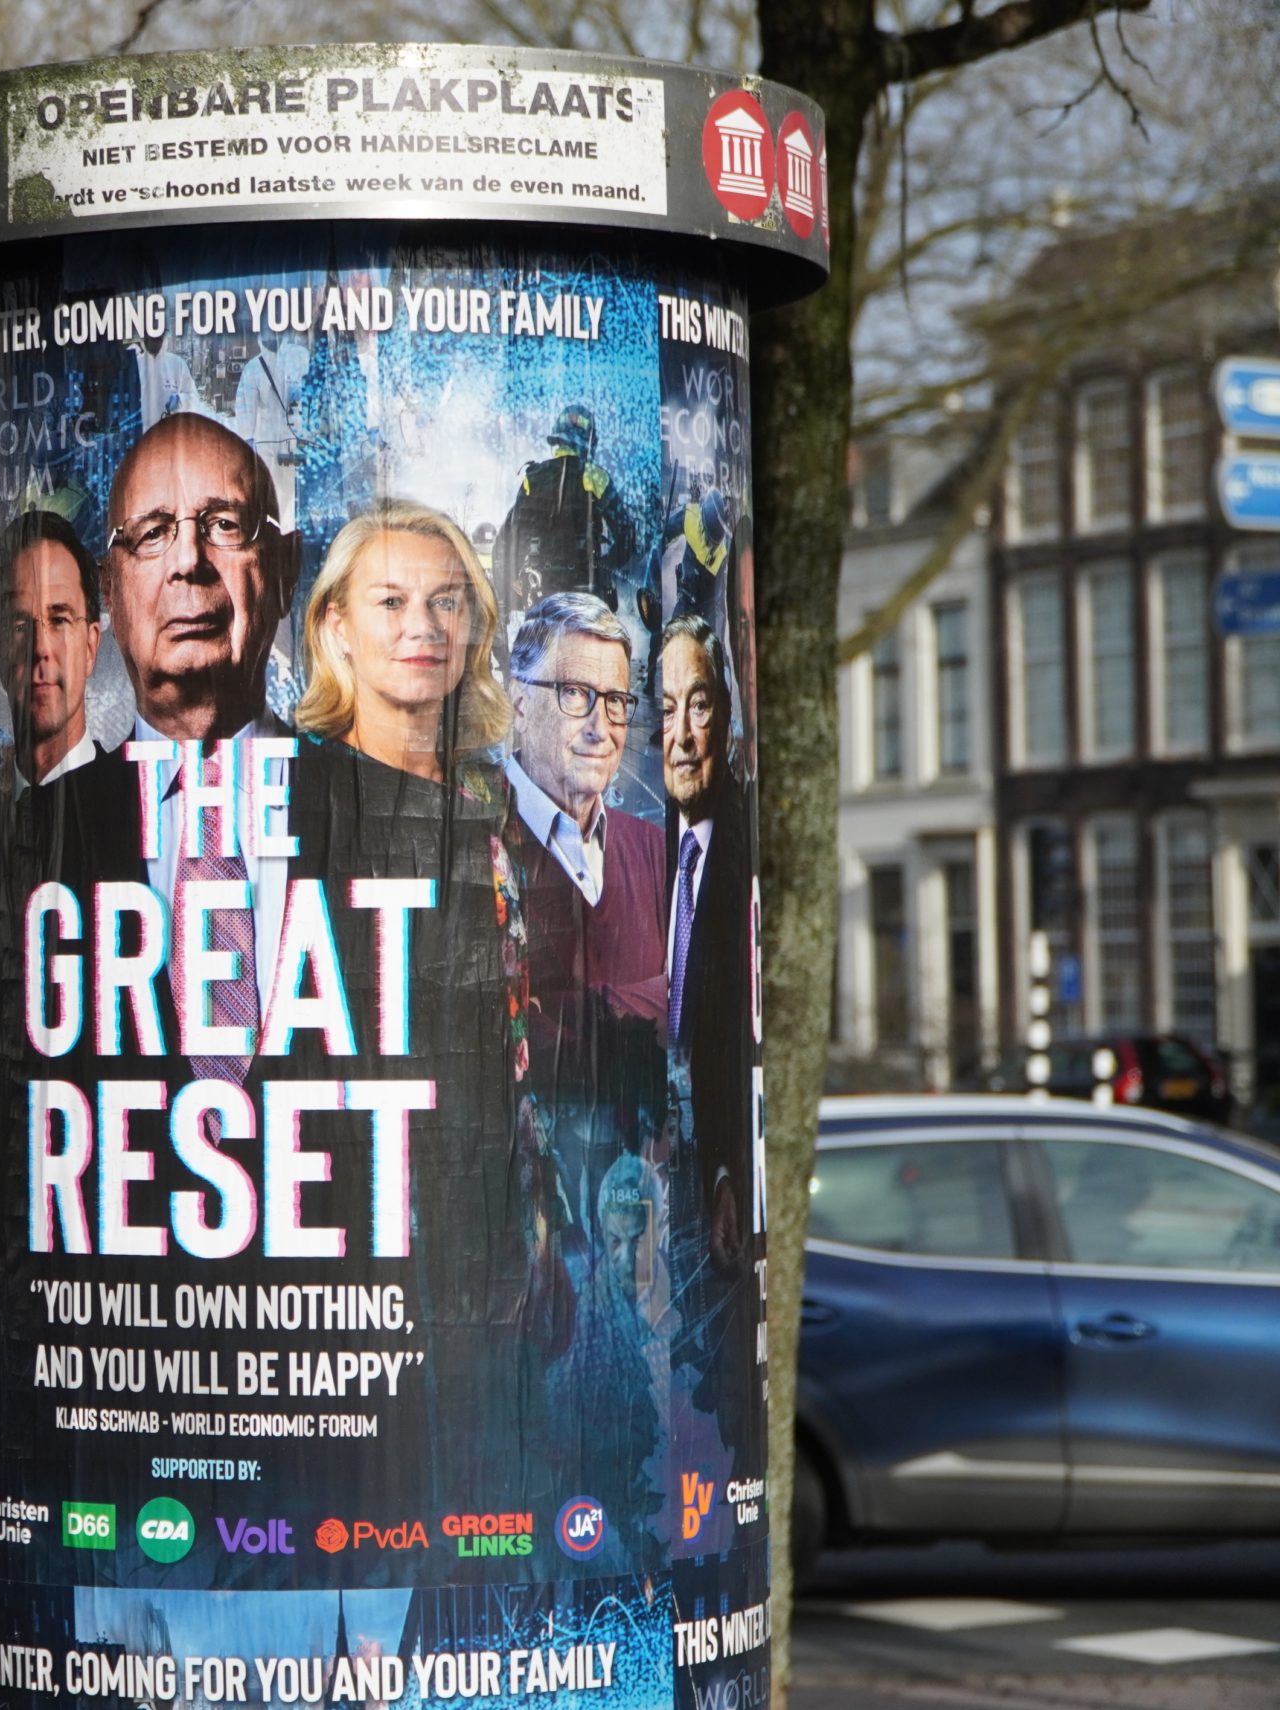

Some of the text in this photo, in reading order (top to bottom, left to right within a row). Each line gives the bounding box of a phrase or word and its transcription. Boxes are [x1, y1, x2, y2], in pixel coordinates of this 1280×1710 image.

[37, 76, 633, 131] OPENBARE PLAKPLAATS
[82, 134, 598, 167] NIET BESTEMD VOOR HANDELSRECLAME
[250, 174, 335, 195] laatste
[346, 173, 411, 192] week
[420, 176, 463, 192] van
[472, 175, 501, 194] de
[510, 179, 563, 195] even
[571, 180, 646, 203] maand.
[54, 294, 165, 347] COMING
[175, 289, 237, 336] FOR
[243, 288, 312, 333] YOU
[322, 287, 393, 331] AND
[401, 286, 490, 335] YOUR
[500, 290, 604, 340] FAMILY
[658, 294, 702, 345] THIS
[125, 738, 300, 859] THE
[25, 879, 437, 1058] GREAT
[27, 1079, 437, 1259] RESET
[99, 1282, 168, 1328] WILL
[175, 1285, 247, 1329] OWN
[256, 1285, 415, 1334] NOTHING,
[33, 1344, 83, 1390] AND
[90, 1347, 146, 1393] YOU
[154, 1350, 228, 1395] WILL
[237, 1351, 280, 1396] BE
[56, 1406, 98, 1431] KLAUS
[100, 1409, 160, 1434] SCHWAB
[171, 1412, 226, 1436] WORLD
[229, 1414, 315, 1437] ECONOMIC
[319, 1415, 378, 1438] FORUM
[151, 1457, 262, 1481] SUPPORTED BY:
[726, 1478, 764, 1504] Christen
[67, 1512, 110, 1538] D66
[140, 1519, 189, 1541] CDA
[441, 1513, 533, 1538] GROEN
[737, 1501, 759, 1525] Unie
[216, 1517, 296, 1554] Volt
[353, 1521, 430, 1550] PvdA
[457, 1534, 533, 1558] LINKS
[673, 1617, 719, 1668] THIS
[65, 1650, 176, 1701] COMING
[185, 1657, 247, 1703] FOR
[253, 1656, 322, 1703] YOU
[332, 1656, 404, 1702] AND
[412, 1650, 501, 1700] YOUR
[509, 1641, 617, 1695] FAMILY
